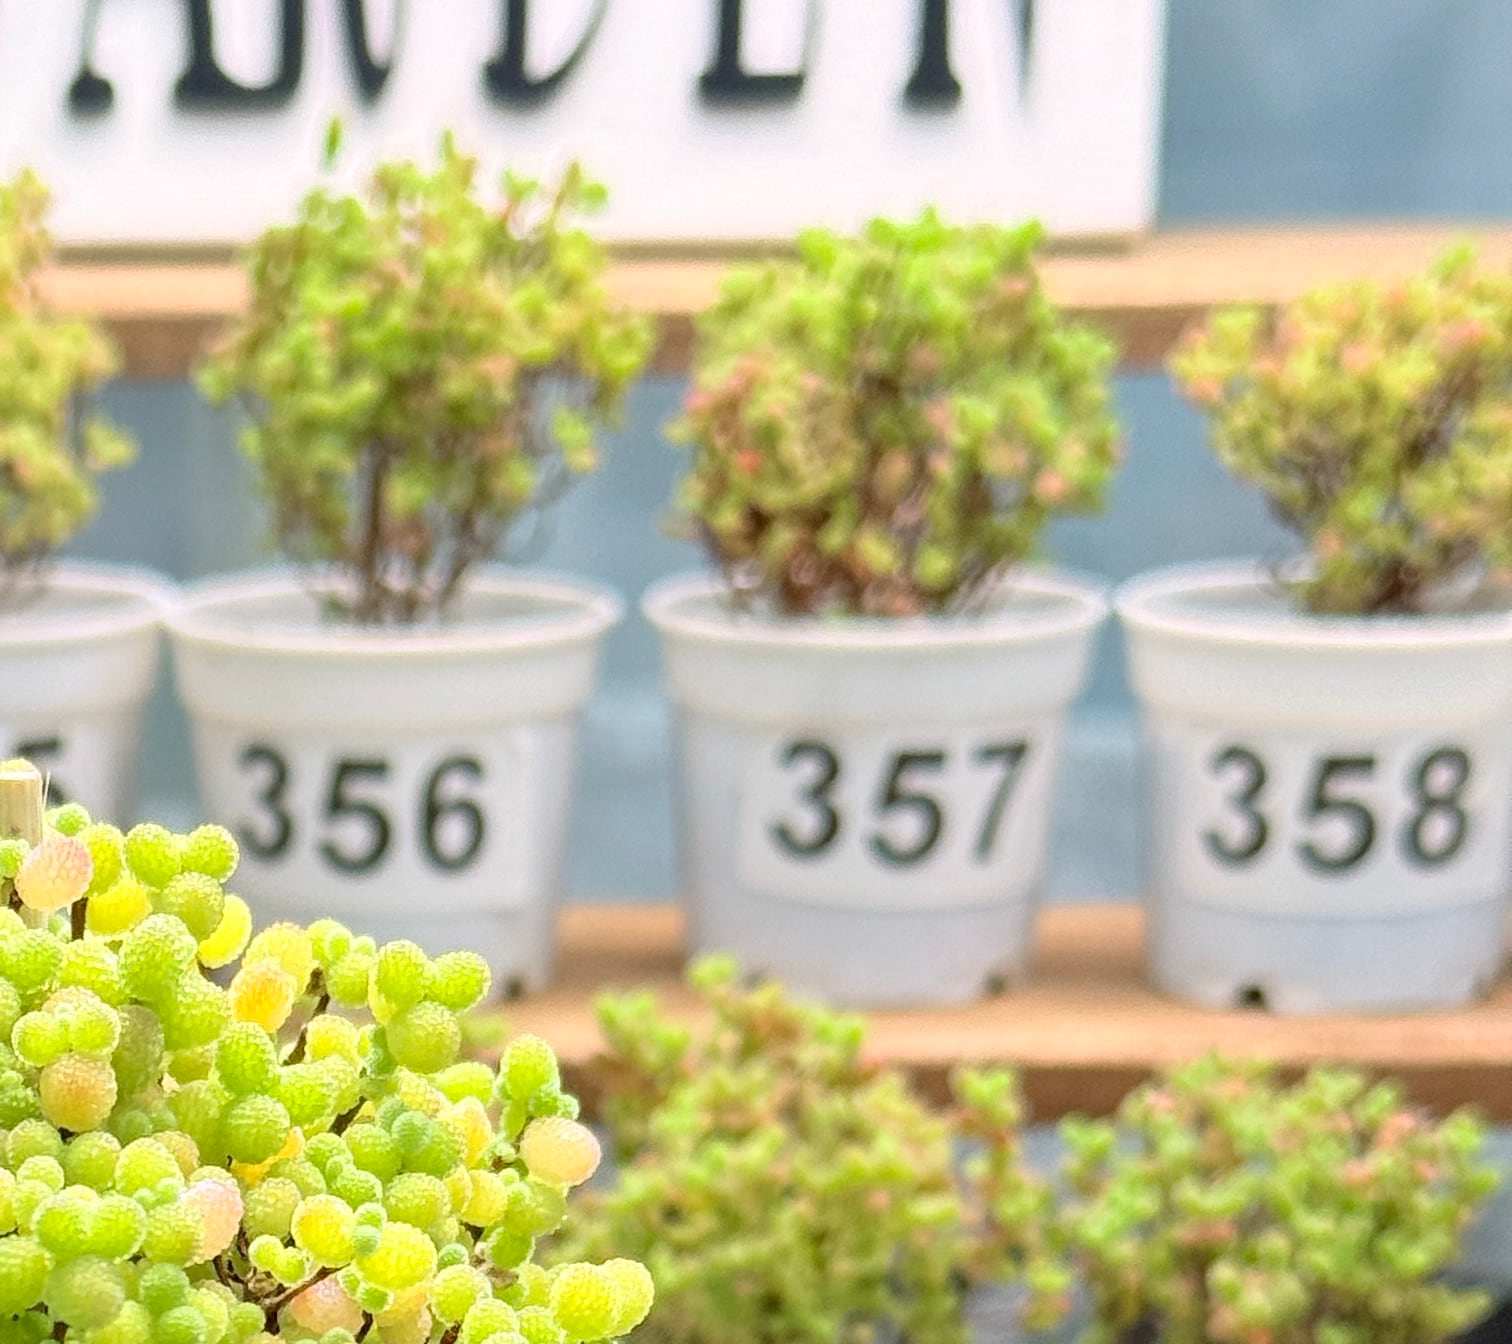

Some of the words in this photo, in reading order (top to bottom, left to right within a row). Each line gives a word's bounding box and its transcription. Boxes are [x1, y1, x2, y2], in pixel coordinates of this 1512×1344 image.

[235, 742, 488, 875] 356
[769, 737, 1030, 867] 357
[1202, 744, 1474, 877] 358
